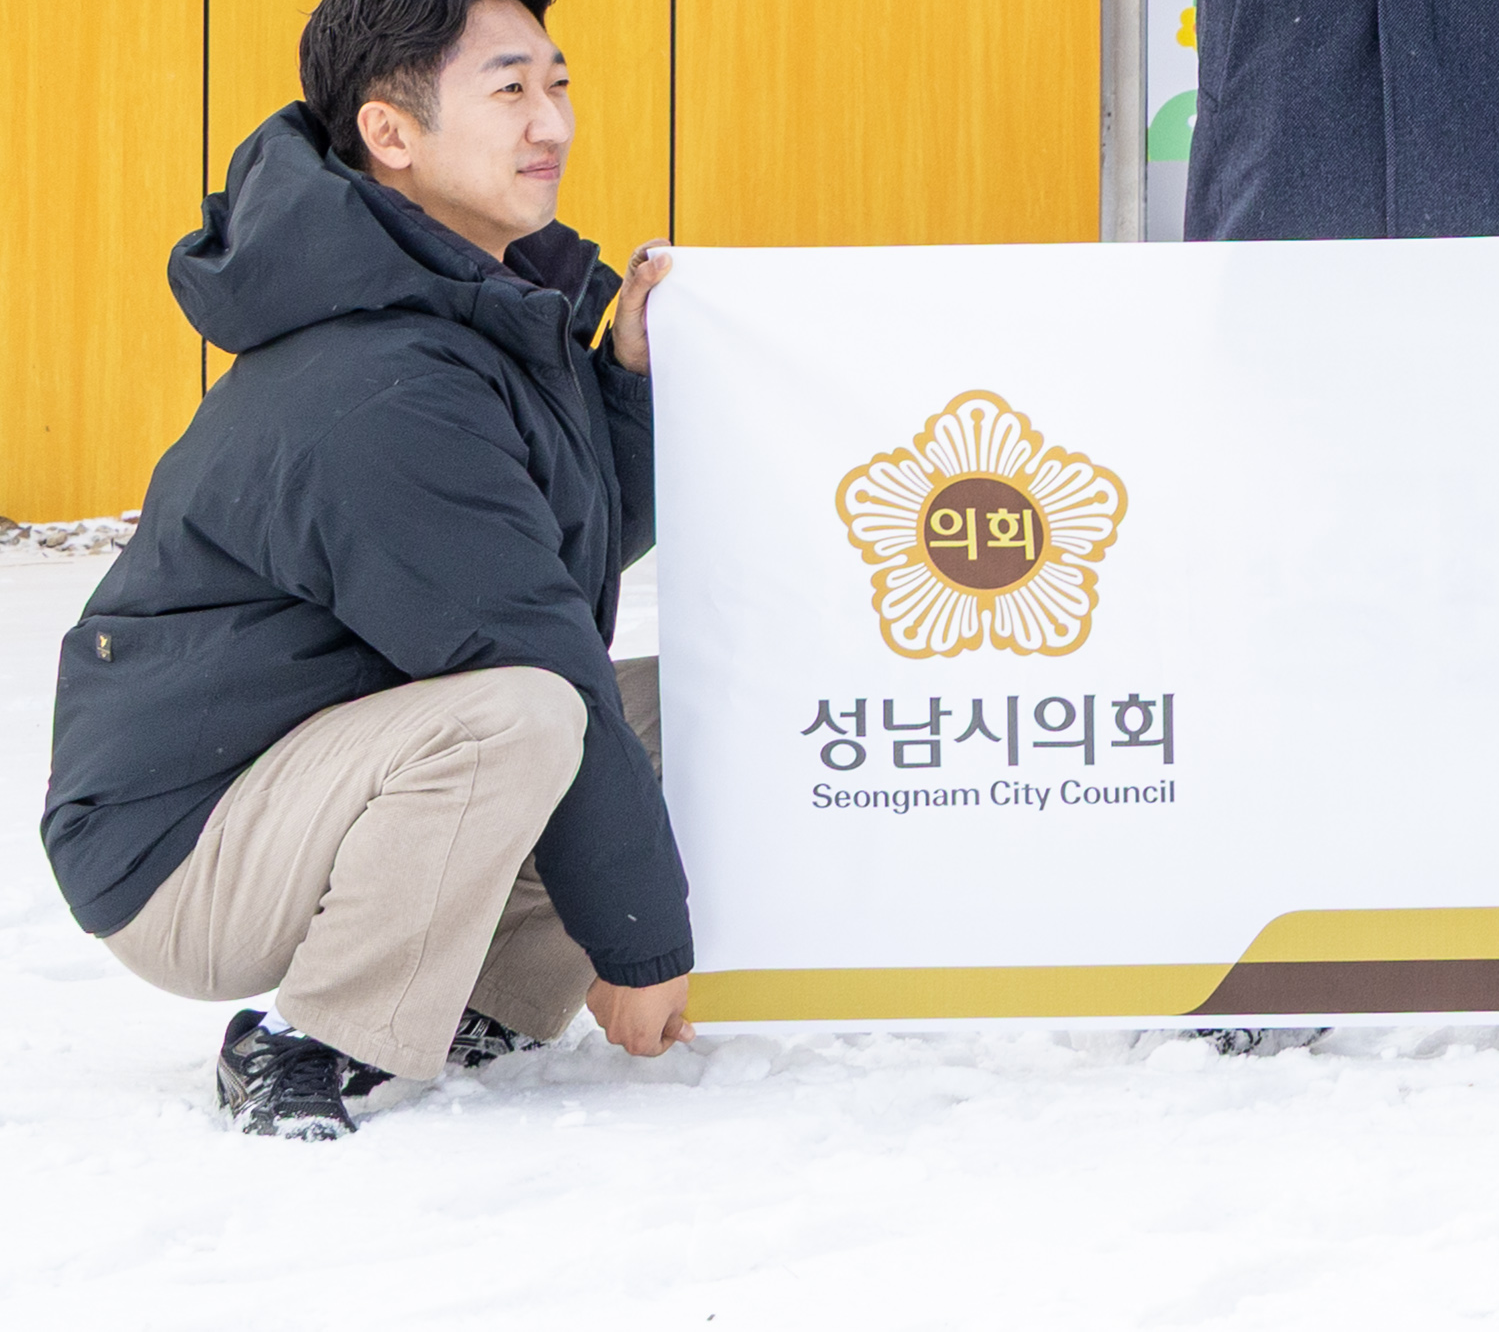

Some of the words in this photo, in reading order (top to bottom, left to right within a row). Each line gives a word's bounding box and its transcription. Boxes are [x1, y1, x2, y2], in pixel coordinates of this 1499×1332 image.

[928, 507, 1037, 562] 의회
[800, 692, 1176, 772] 성남시의회
[811, 781, 981, 815] Seongnam
[988, 778, 1052, 812] City
[1059, 778, 1176, 805] Council
